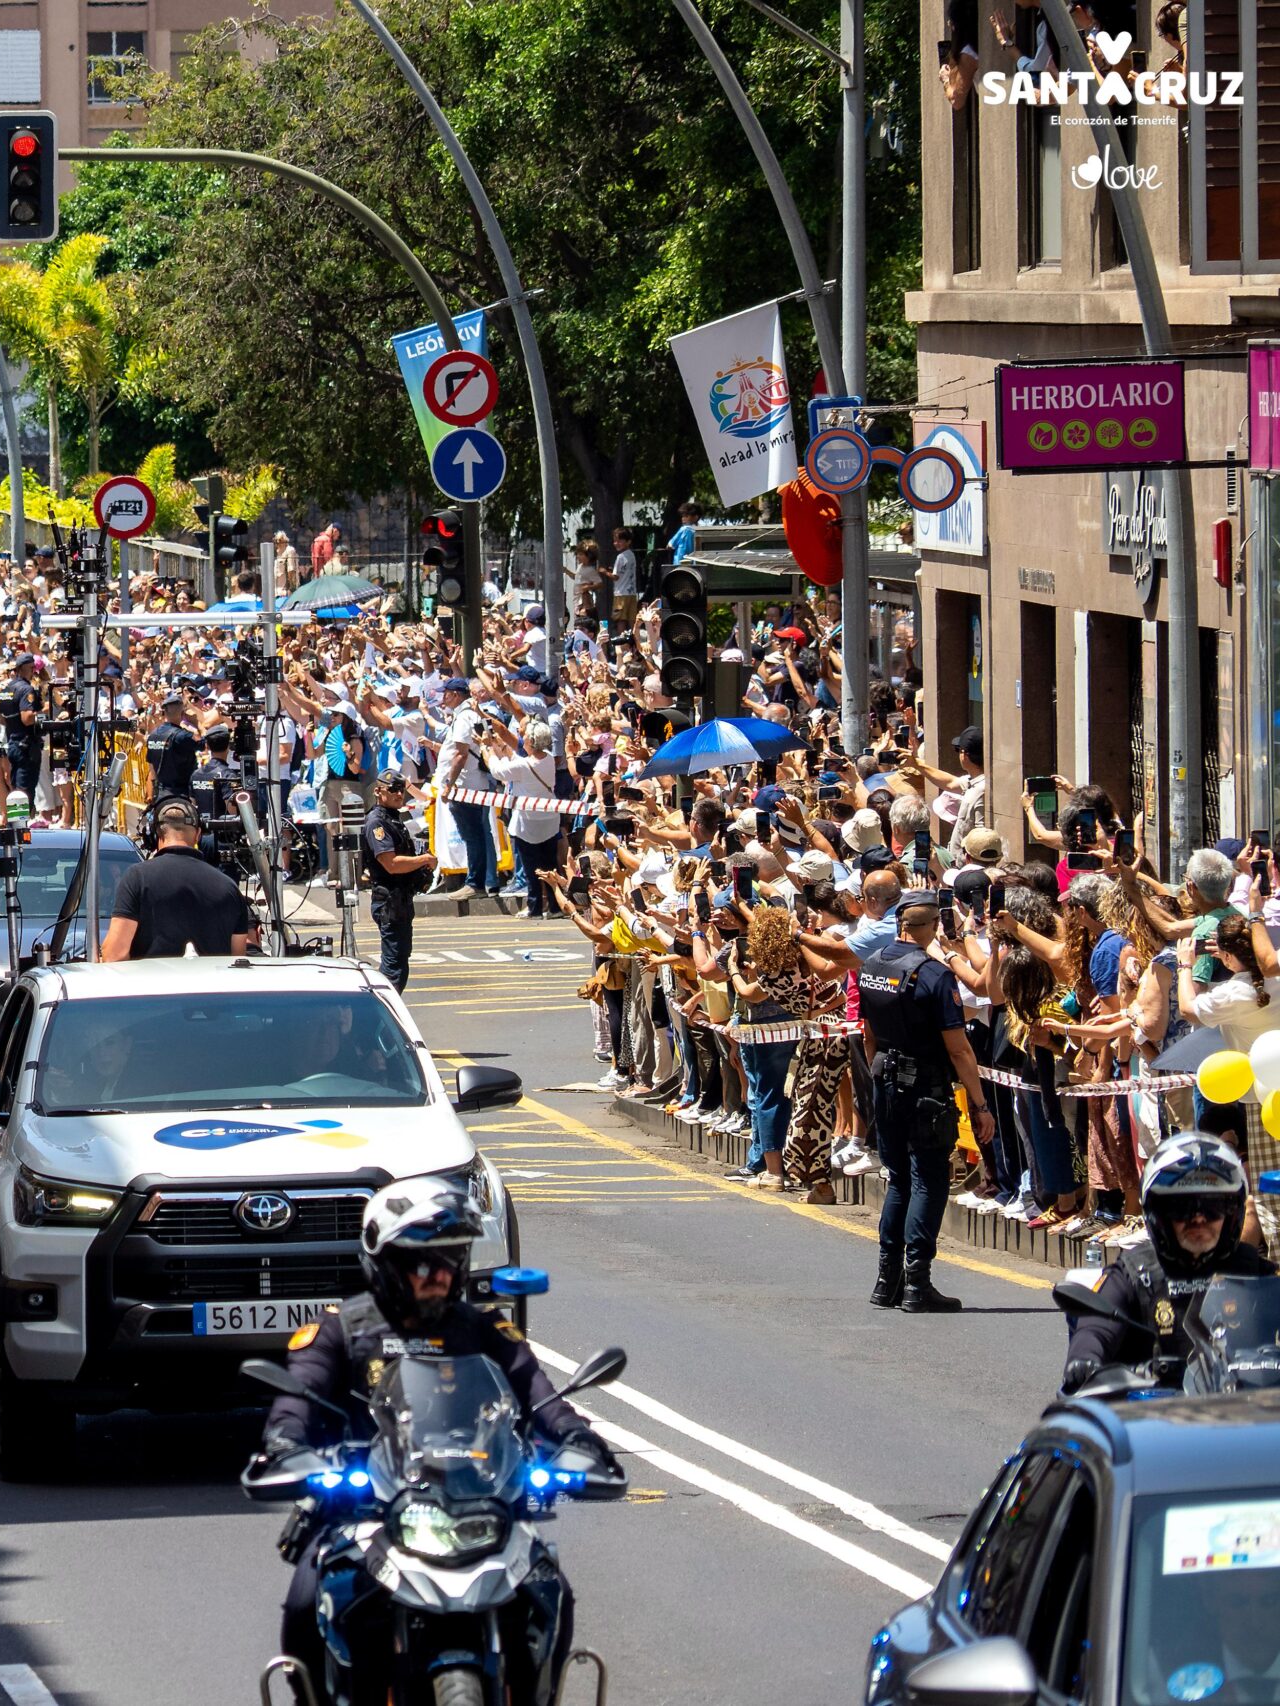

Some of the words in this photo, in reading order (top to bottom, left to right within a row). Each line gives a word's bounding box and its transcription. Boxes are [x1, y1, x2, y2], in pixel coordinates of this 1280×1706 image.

[406, 335, 445, 359] LEÓN
[1011, 381, 1174, 411] HERBOLARIO
[720, 442, 754, 468] alzad
[757, 440, 768, 455] la
[770, 429, 795, 449] mira
[835, 458, 859, 470] TITS
[860, 980, 898, 994] NACIONAL
[861, 973, 891, 985] POLICIA
[212, 1306, 277, 1330] 5612
[287, 1303, 337, 1328] NN
[410, 1449, 474, 1461] PLICIA
